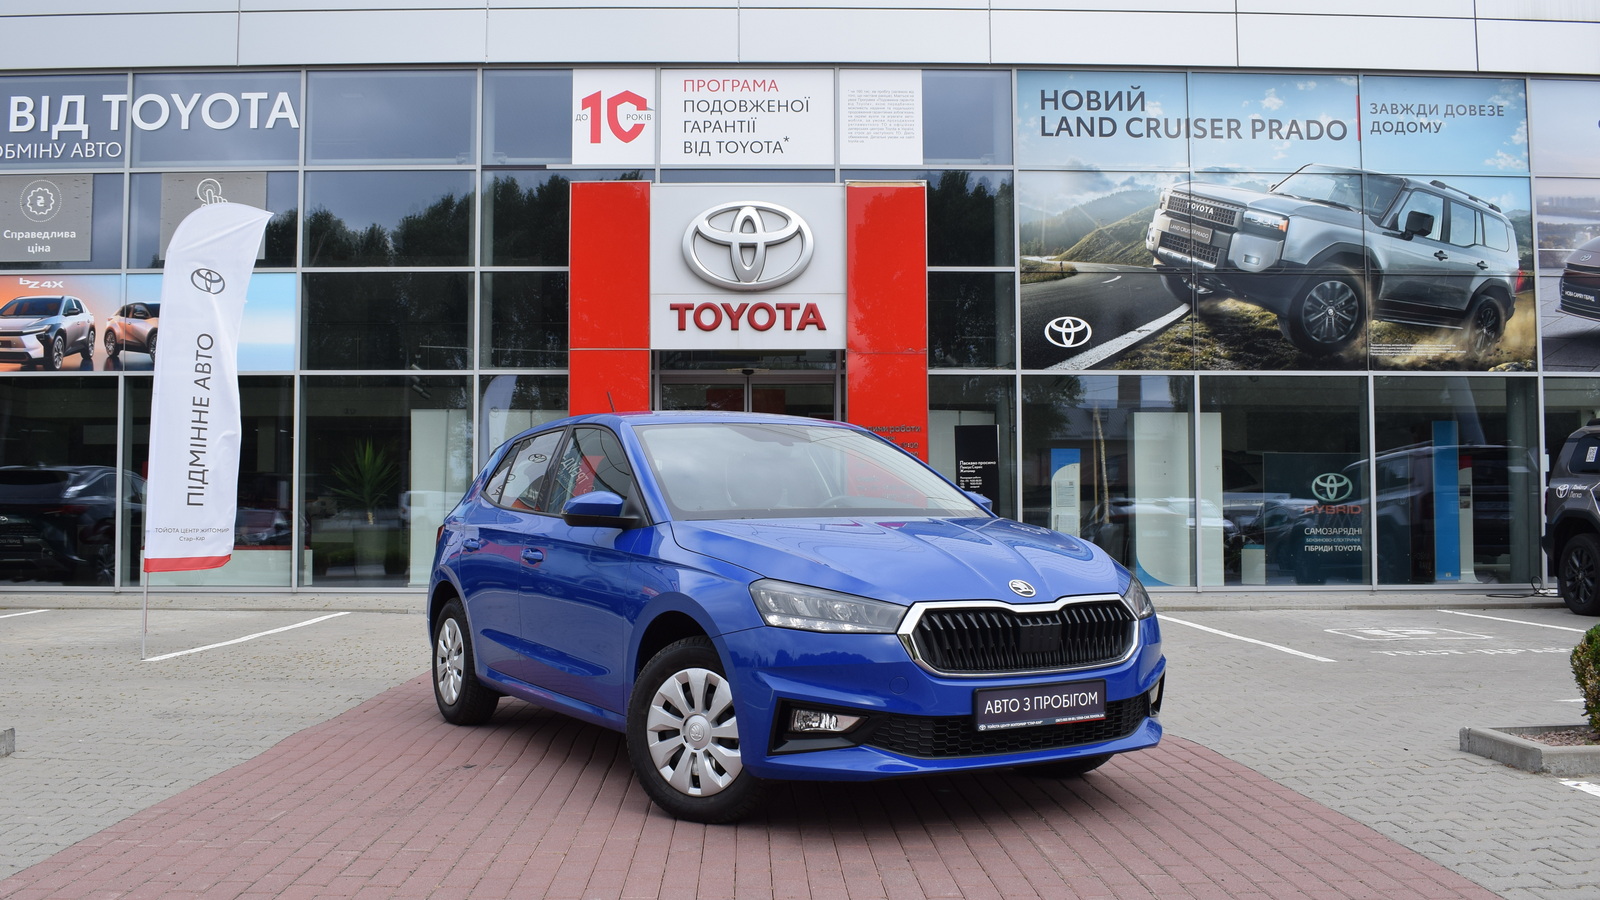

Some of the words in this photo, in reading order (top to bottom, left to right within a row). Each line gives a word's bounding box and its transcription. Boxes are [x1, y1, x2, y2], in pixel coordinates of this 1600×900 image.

[683, 79, 779, 92] ПРОГРАМА
[683, 96, 810, 115] ПОДОВЖЕНОЇ
[1040, 85, 1146, 111] НОВИЙ
[9, 95, 89, 140] ВІД
[102, 92, 300, 131] TOYOTA
[575, 113, 588, 121] ДО
[626, 113, 652, 121] РОКІВ
[581, 90, 648, 144] 10
[1369, 103, 1439, 118] ЗАВЖДИ
[1443, 104, 1505, 118] ДОВЕЗЕ
[683, 117, 757, 133] ГАРАНТІЇ
[1040, 116, 1117, 137] LAND
[1125, 117, 1243, 140] CRUISER
[1251, 119, 1348, 141] PRADO
[1370, 121, 1442, 135] ДОДОМУ
[0, 143, 66, 159] БМІНУ
[70, 142, 122, 158] АВТО
[683, 141, 711, 156] ВІД
[1186, 202, 1214, 215] TOYOTA
[3, 230, 77, 241] Справедлива
[27, 243, 51, 254] ціна
[669, 302, 827, 332] TOYOTA
[193, 333, 214, 391] АВТО
[186, 395, 210, 507] ПІДМІННЕ
[1304, 504, 1362, 514] HYBRID
[180, 527, 200, 535] ЦЕНТР
[1304, 527, 1363, 535] САМОЗАРЯДНІ
[1304, 545, 1333, 553] ГІБРИДИ
[984, 698, 1020, 714] АВТО
[1023, 697, 1031, 711] З
[1033, 691, 1098, 710] ПРОБІГОМ
